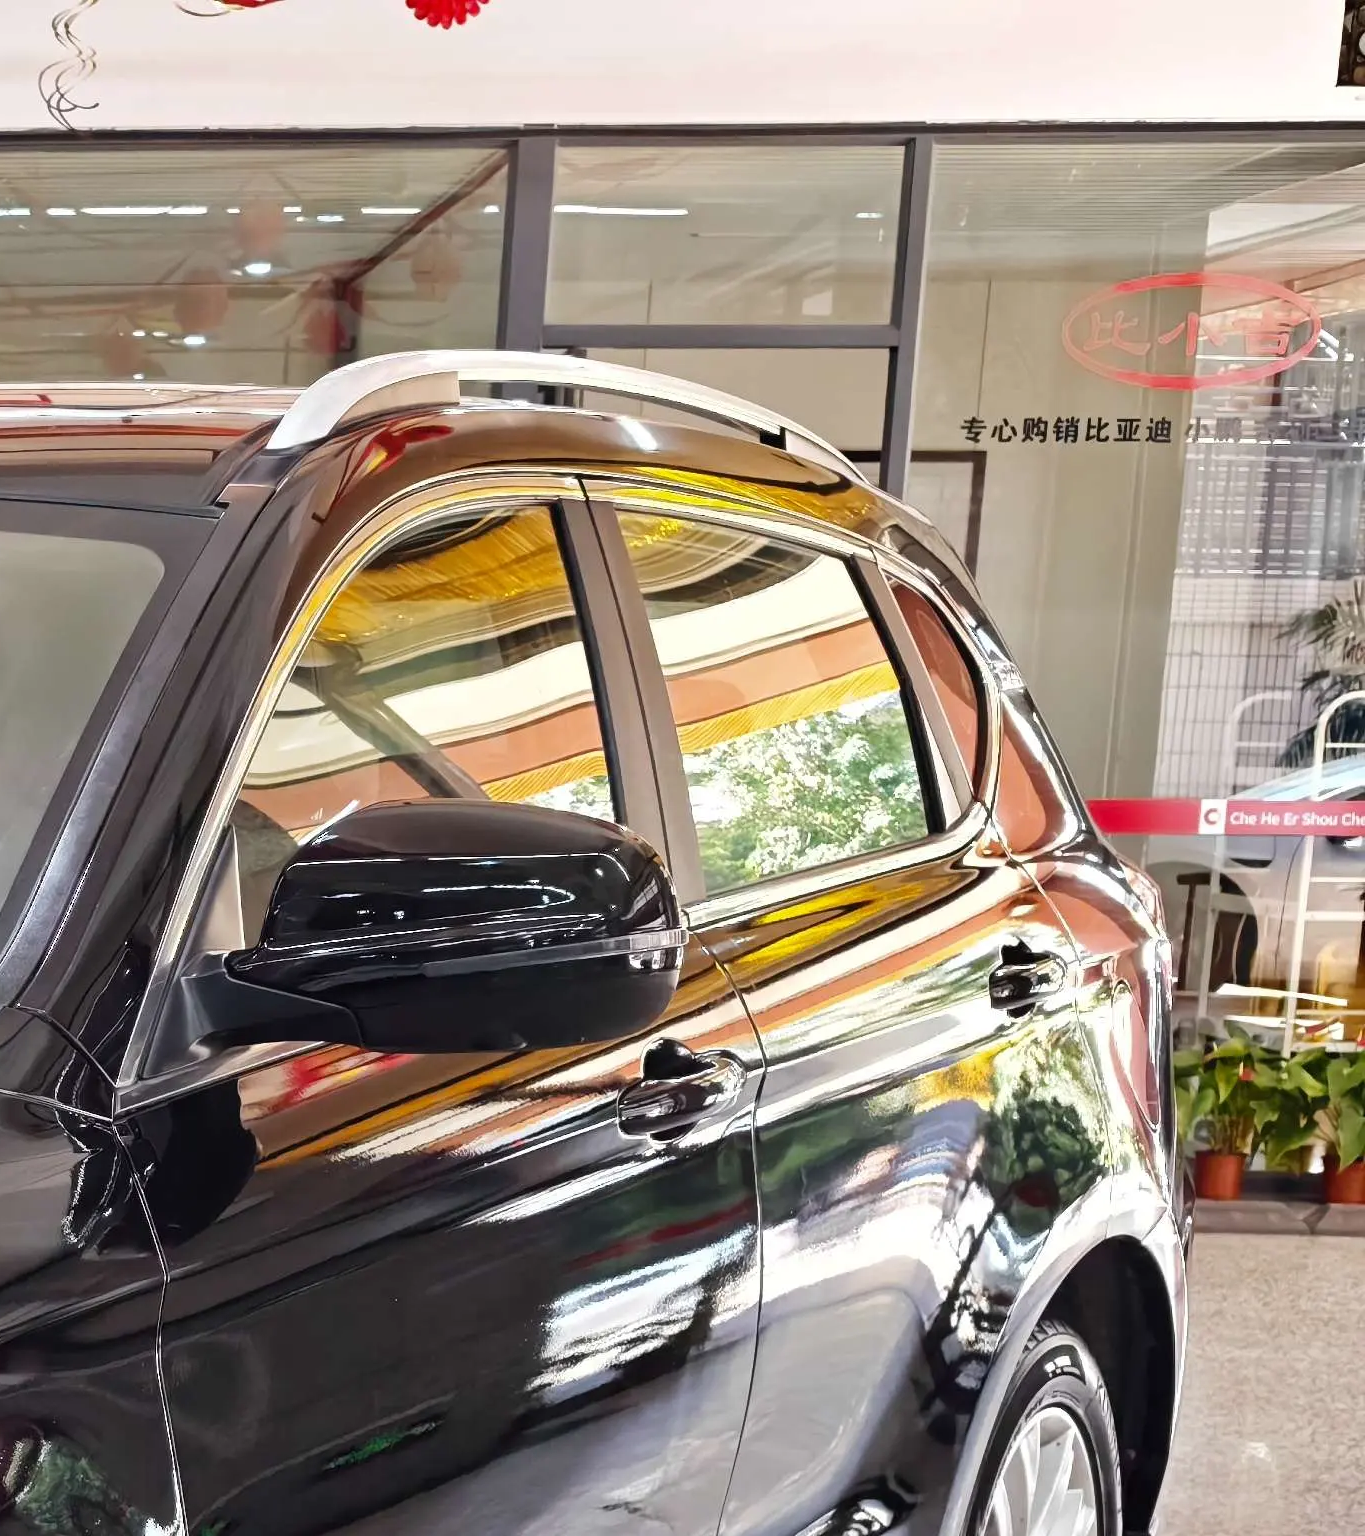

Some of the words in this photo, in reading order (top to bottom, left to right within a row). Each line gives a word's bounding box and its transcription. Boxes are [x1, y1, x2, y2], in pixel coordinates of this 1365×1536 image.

[960, 416, 1173, 444] 专心购销比亚迪
[1230, 811, 1257, 825] Che
[1261, 811, 1280, 826] He
[1283, 812, 1300, 826] Er
[1302, 811, 1338, 826] Shou
